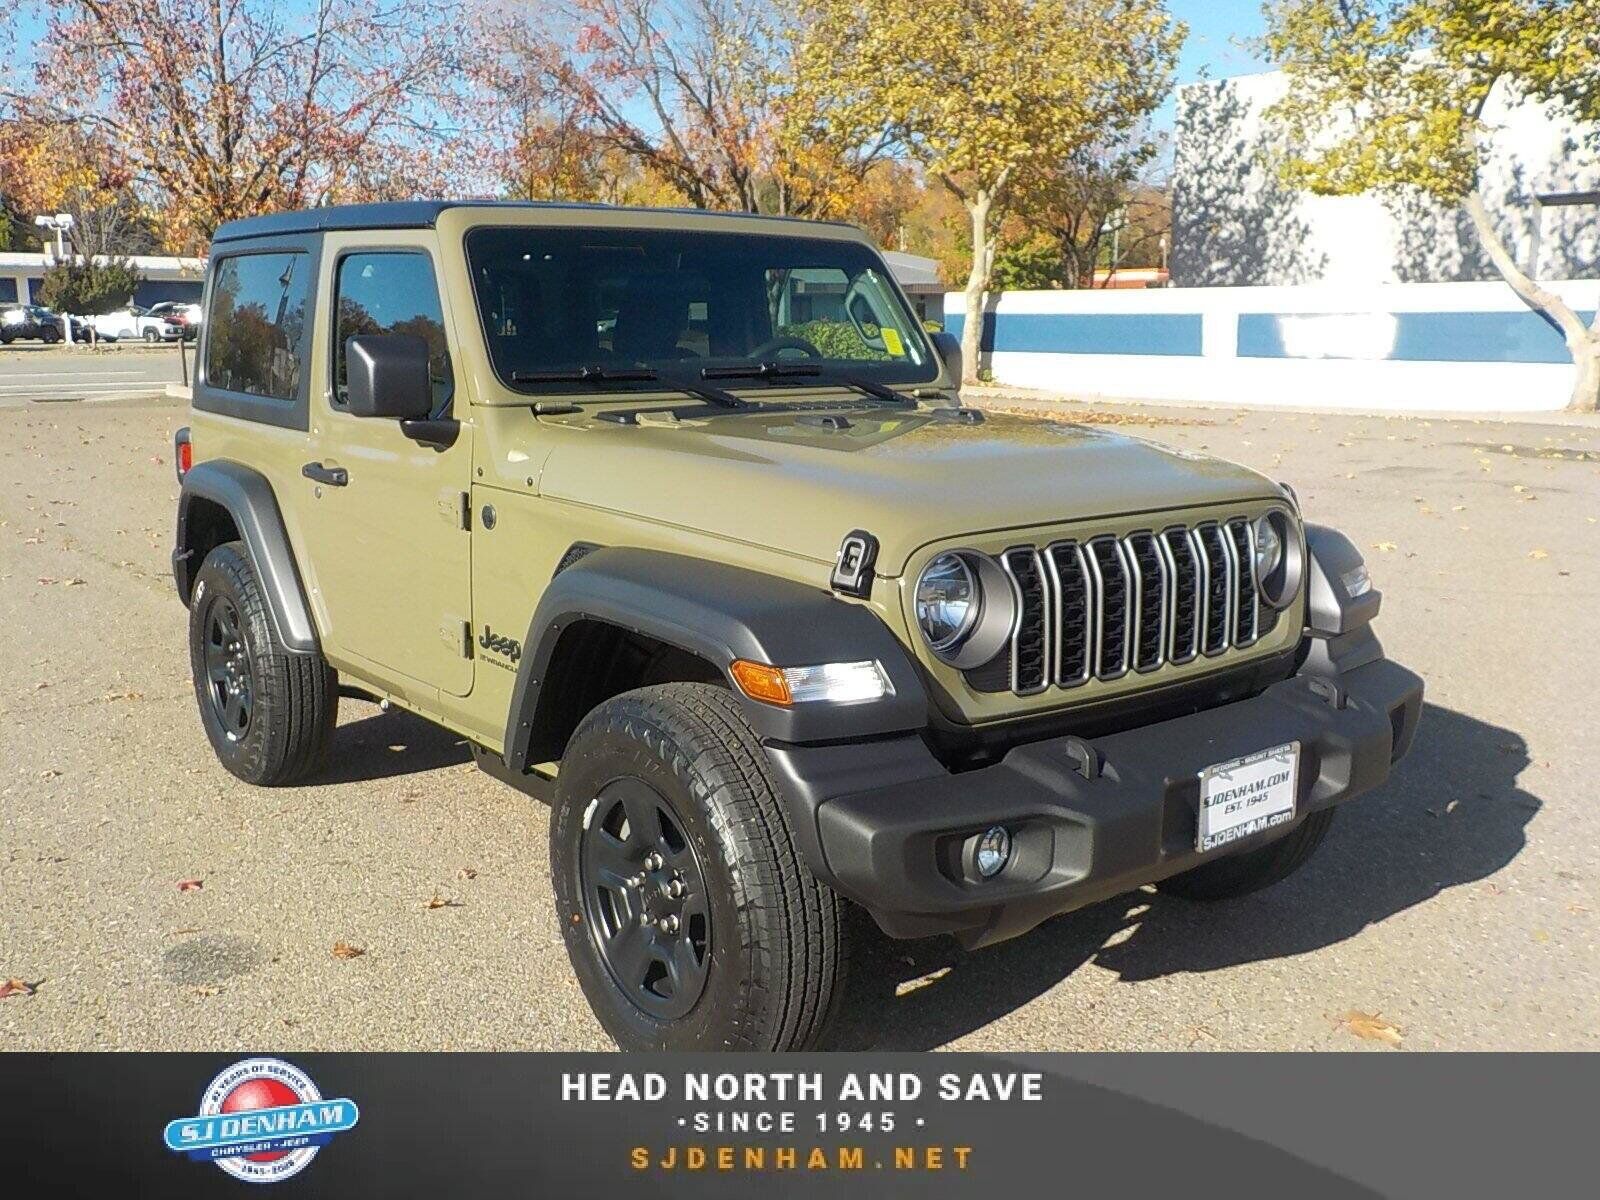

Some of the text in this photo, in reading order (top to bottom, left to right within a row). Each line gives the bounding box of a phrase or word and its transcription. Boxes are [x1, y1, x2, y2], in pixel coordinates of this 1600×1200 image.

[479, 624, 521, 664] Jeep
[1203, 770, 1290, 809] SJDENHAM.COM
[1224, 791, 1269, 815] EST. 1945
[1203, 812, 1292, 850] SJDENHAM.com
